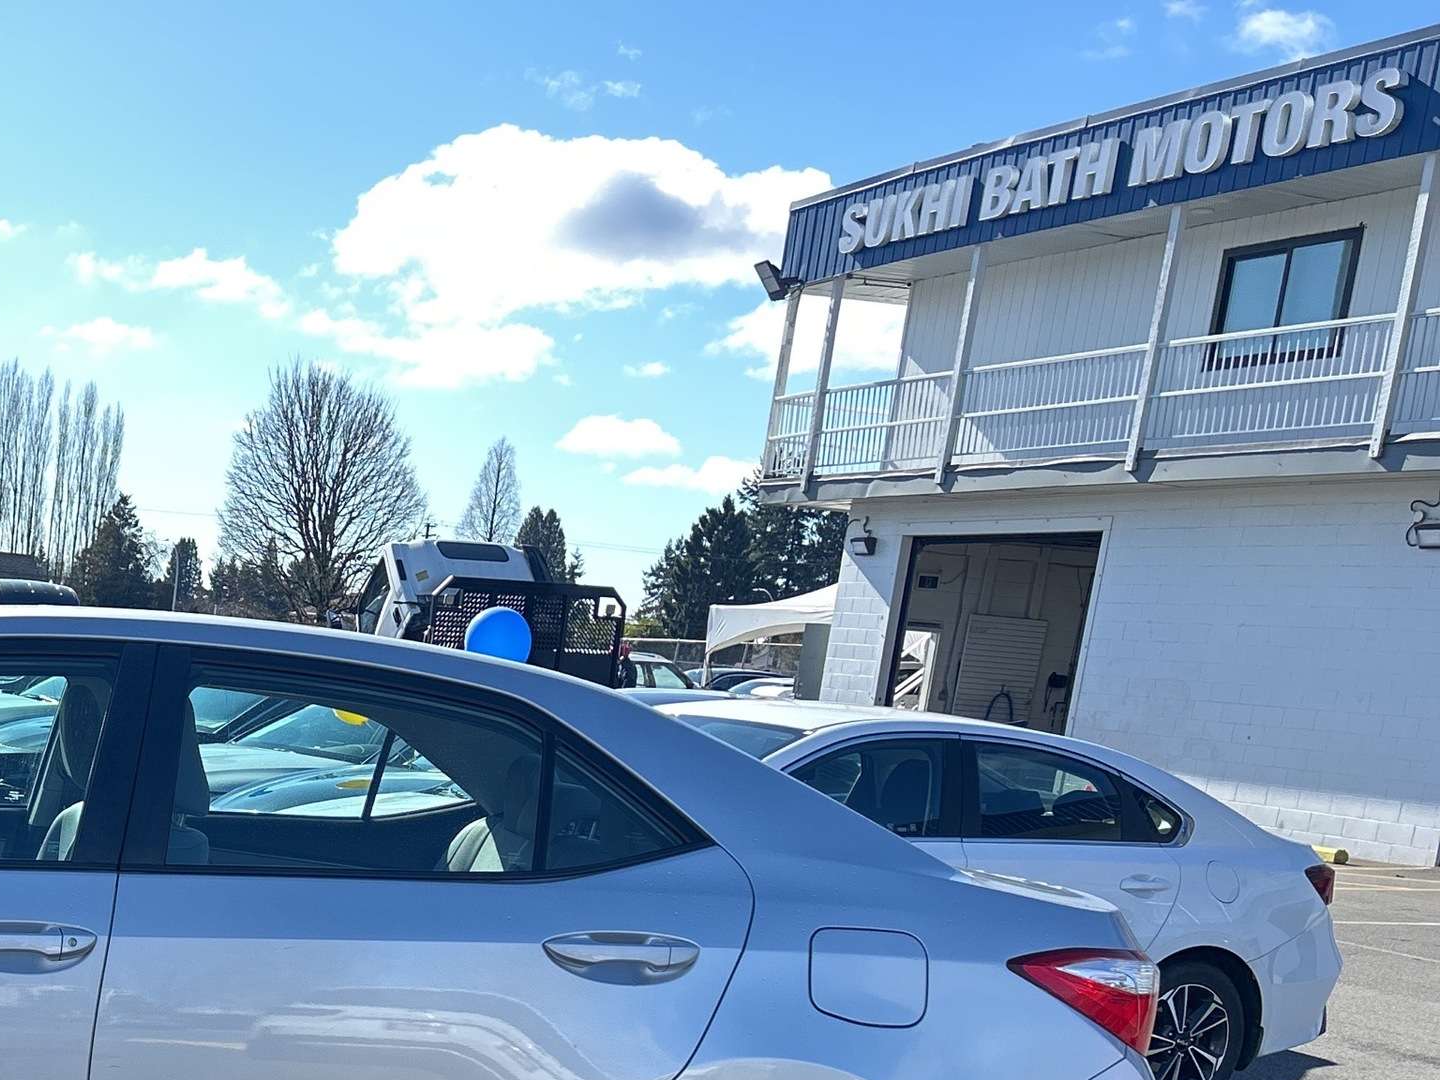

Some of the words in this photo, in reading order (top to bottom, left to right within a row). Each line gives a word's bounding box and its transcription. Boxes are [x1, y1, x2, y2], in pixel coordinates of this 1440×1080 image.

[838, 173, 976, 255] SUKHI
[978, 137, 1121, 222] BATH
[1126, 68, 1407, 187] MOTORS
